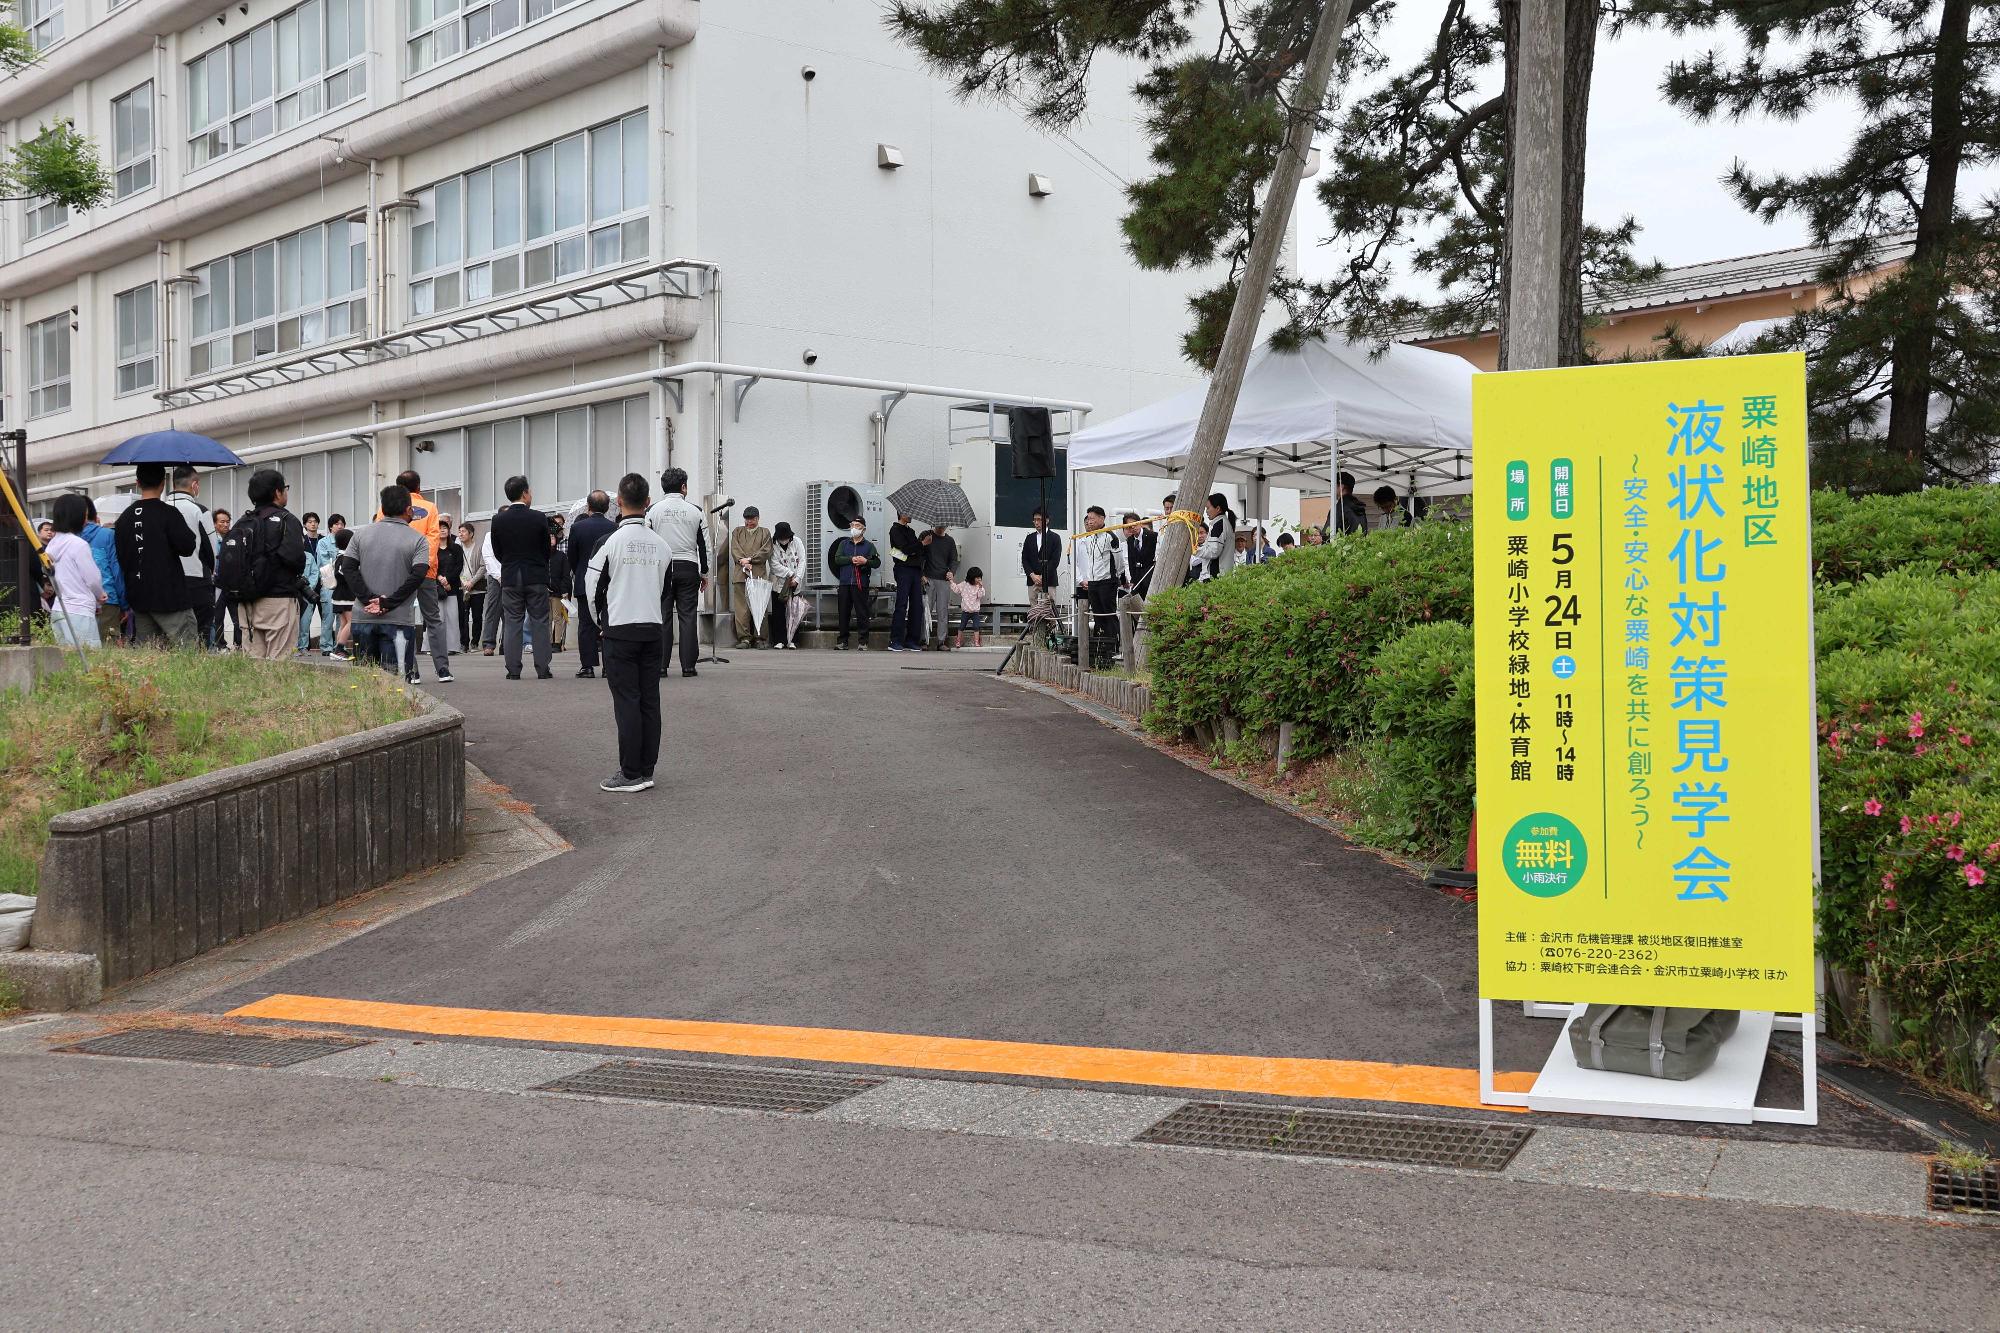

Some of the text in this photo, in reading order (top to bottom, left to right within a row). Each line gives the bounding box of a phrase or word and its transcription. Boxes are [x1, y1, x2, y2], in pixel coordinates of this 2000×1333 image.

[1741, 395, 1780, 548] 粟崎地区
[1510, 469, 1526, 512] 場所
[1554, 466, 1570, 513] 開催日
[627, 541, 657, 554] 金沢市
[1507, 535, 1532, 782] 粟崎小学校緑地・体育館
[1666, 399, 1731, 903] 液状化対策見学会
[1530, 826, 1559, 837] 参加費
[1515, 839, 1575, 869] 無料
[1522, 871, 1568, 884] 小雨決行
[1577, 932, 1634, 946] 危機管理課
[1638, 934, 1743, 949] 被災地区復旧推進室
[1764, 969, 1788, 981] ほか
